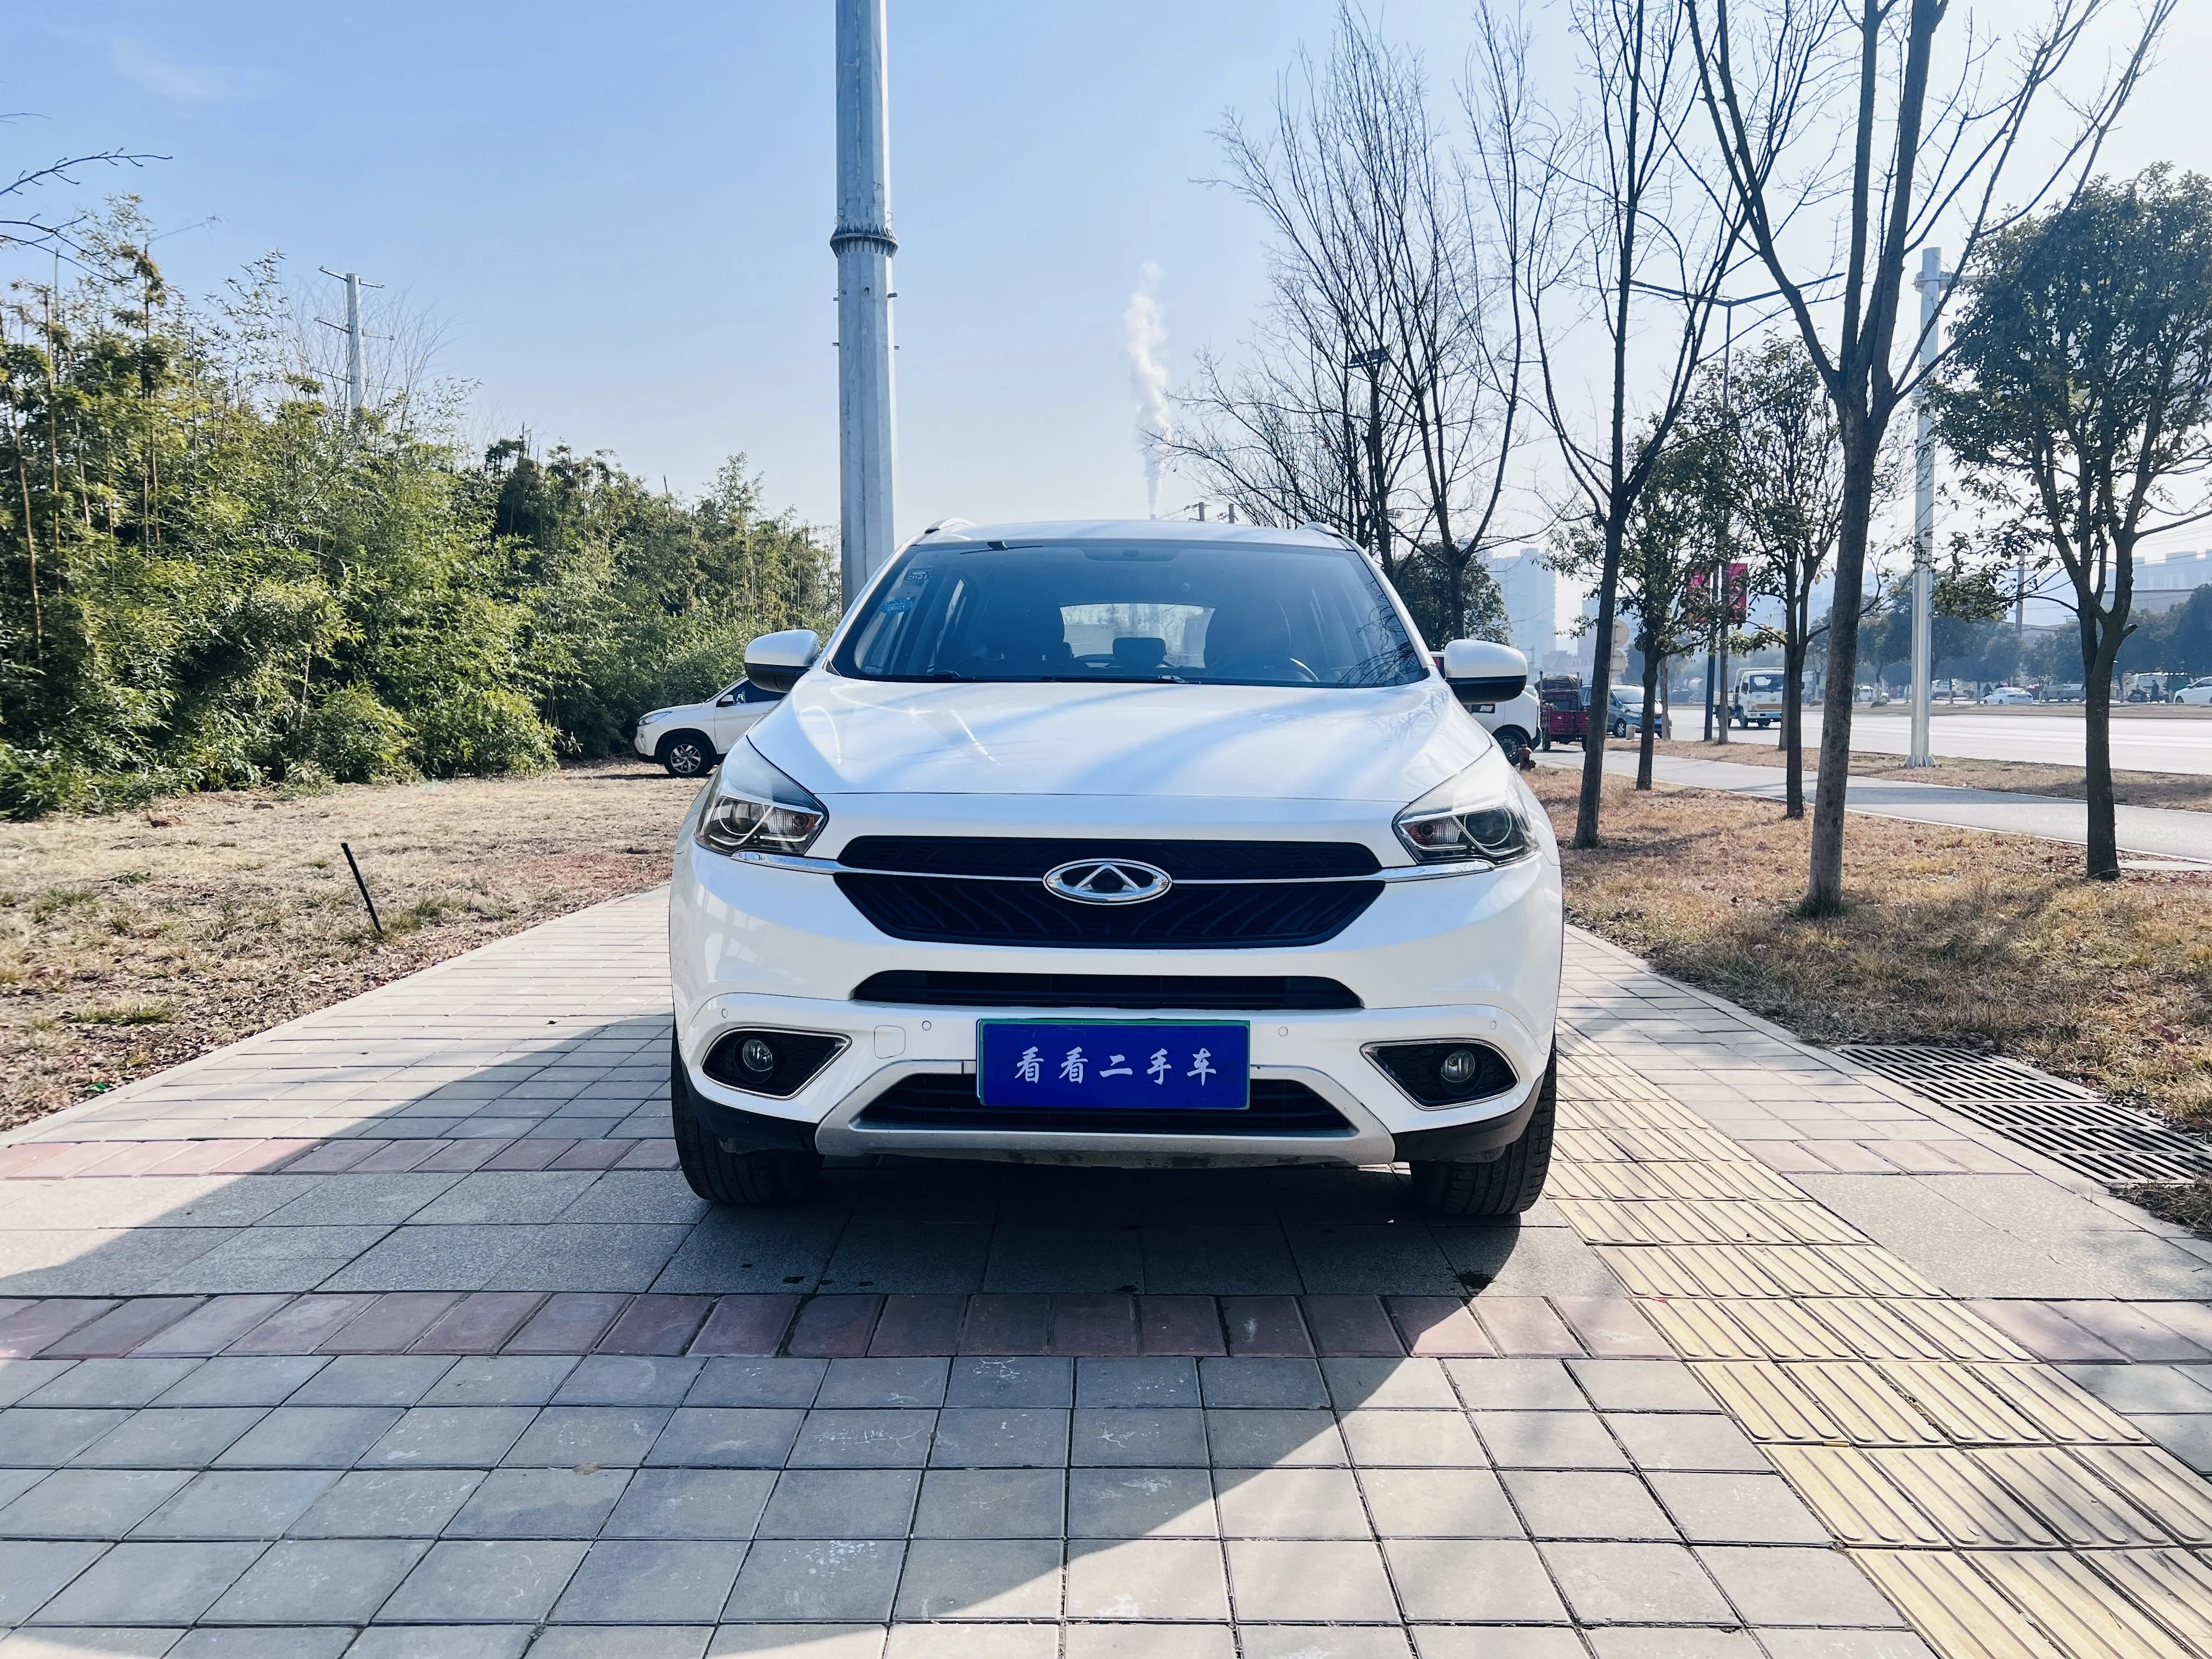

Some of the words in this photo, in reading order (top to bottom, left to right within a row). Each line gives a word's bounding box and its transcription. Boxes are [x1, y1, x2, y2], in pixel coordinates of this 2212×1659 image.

[1014, 1046, 1217, 1086] 看看二手车
